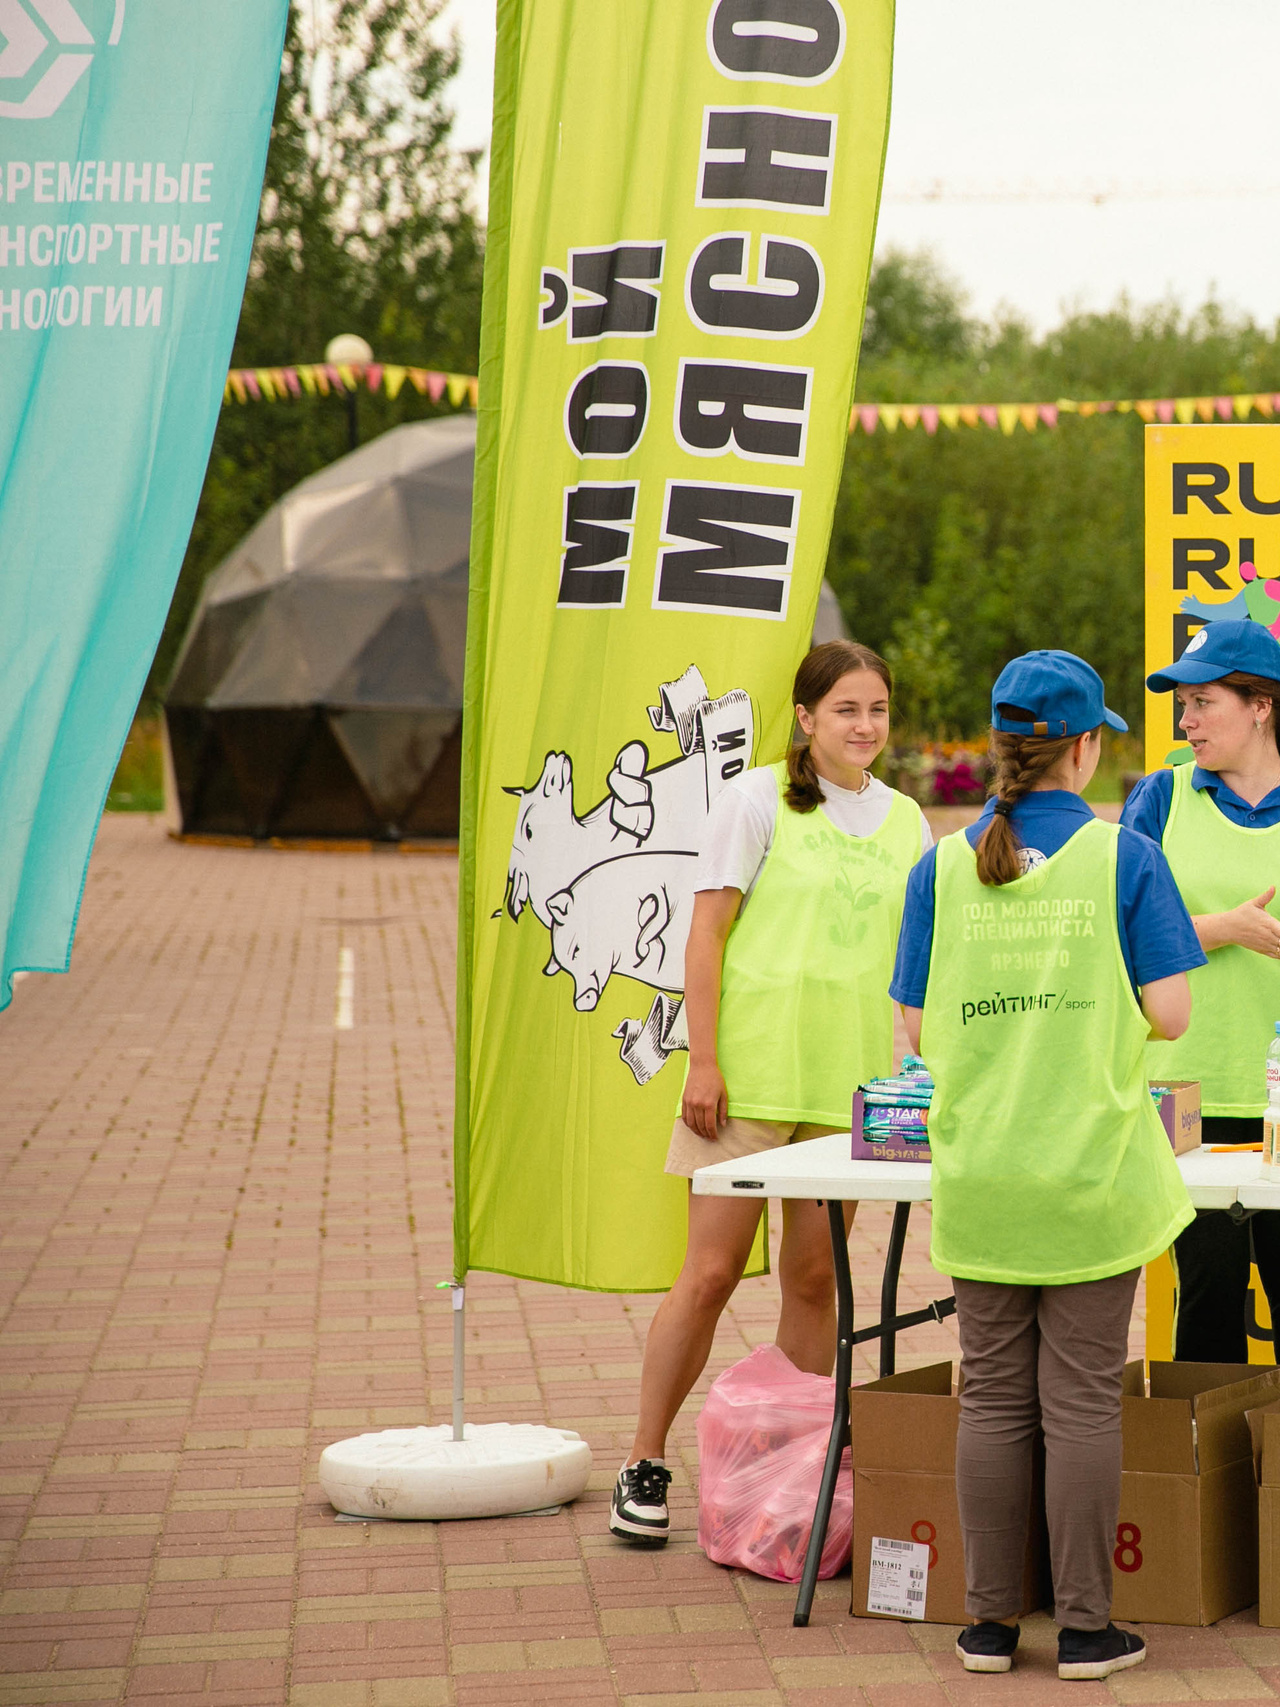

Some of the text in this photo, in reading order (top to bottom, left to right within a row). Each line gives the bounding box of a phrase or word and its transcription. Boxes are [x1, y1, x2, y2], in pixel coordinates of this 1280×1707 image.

[0, 160, 214, 204] РЕМЕННЫЕ
[652, 0, 846, 621] МЯСНО
[539, 240, 667, 609] МОЙ
[711, 727, 746, 781] ОЙ
[962, 898, 1096, 922] ГОД МОЛОДОГО
[962, 918, 1096, 942] СПЕЦИАЛИСТА
[1114, 1522, 1143, 1573] 8
